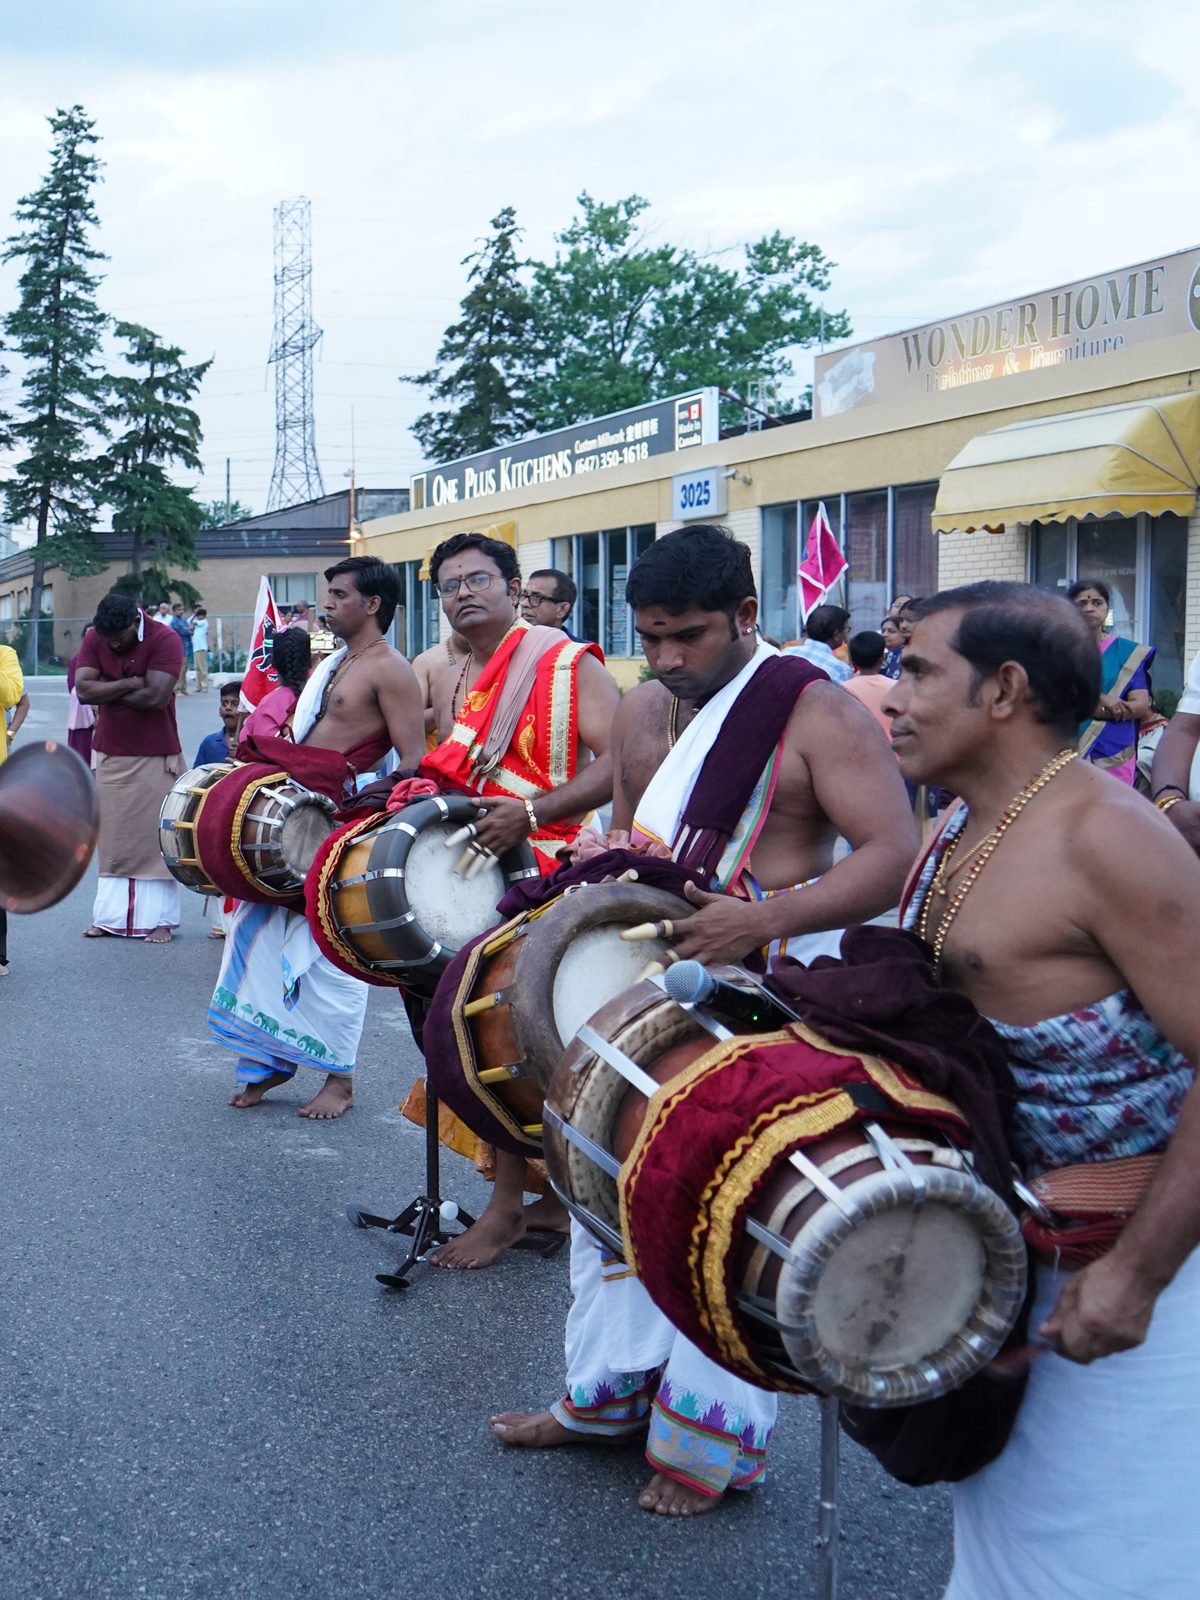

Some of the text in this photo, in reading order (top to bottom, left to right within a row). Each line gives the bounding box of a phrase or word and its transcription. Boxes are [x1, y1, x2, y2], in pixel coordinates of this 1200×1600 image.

[902, 266, 1165, 373] WONDER HOME
[1003, 352, 1020, 375] &
[1029, 336, 1124, 370] Furniture
[681, 480, 710, 509] 3025
